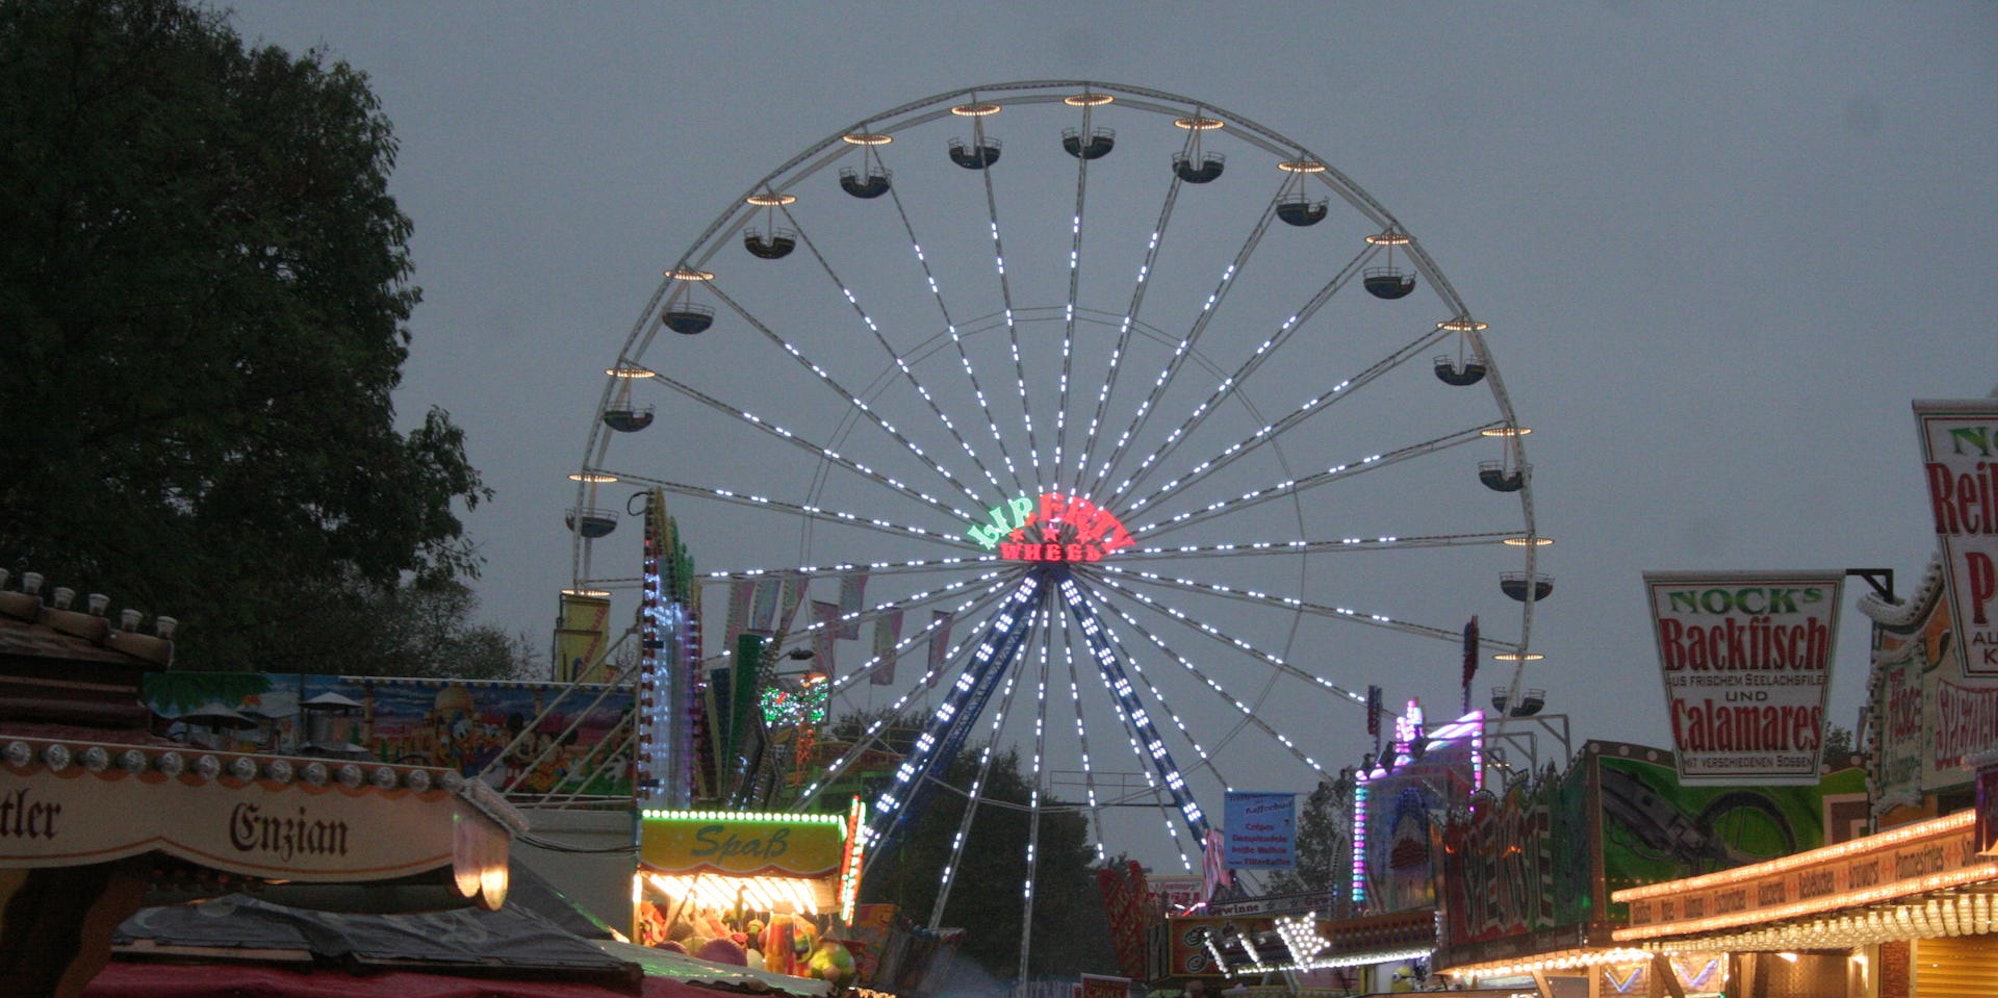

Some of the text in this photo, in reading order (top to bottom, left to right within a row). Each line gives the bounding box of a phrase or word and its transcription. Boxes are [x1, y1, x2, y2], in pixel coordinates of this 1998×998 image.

[1947, 426, 1998, 456] N
[1925, 461, 1998, 535] Rei
[1001, 543, 1102, 562] WHEEL
[1658, 616, 1828, 671] Backfisch
[1690, 675, 1743, 687] FRISCHEM
[1725, 691, 1768, 701] UND
[1671, 698, 1823, 751] Calamares
[230, 802, 349, 863] Enzian
[690, 825, 791, 867] Spaß
